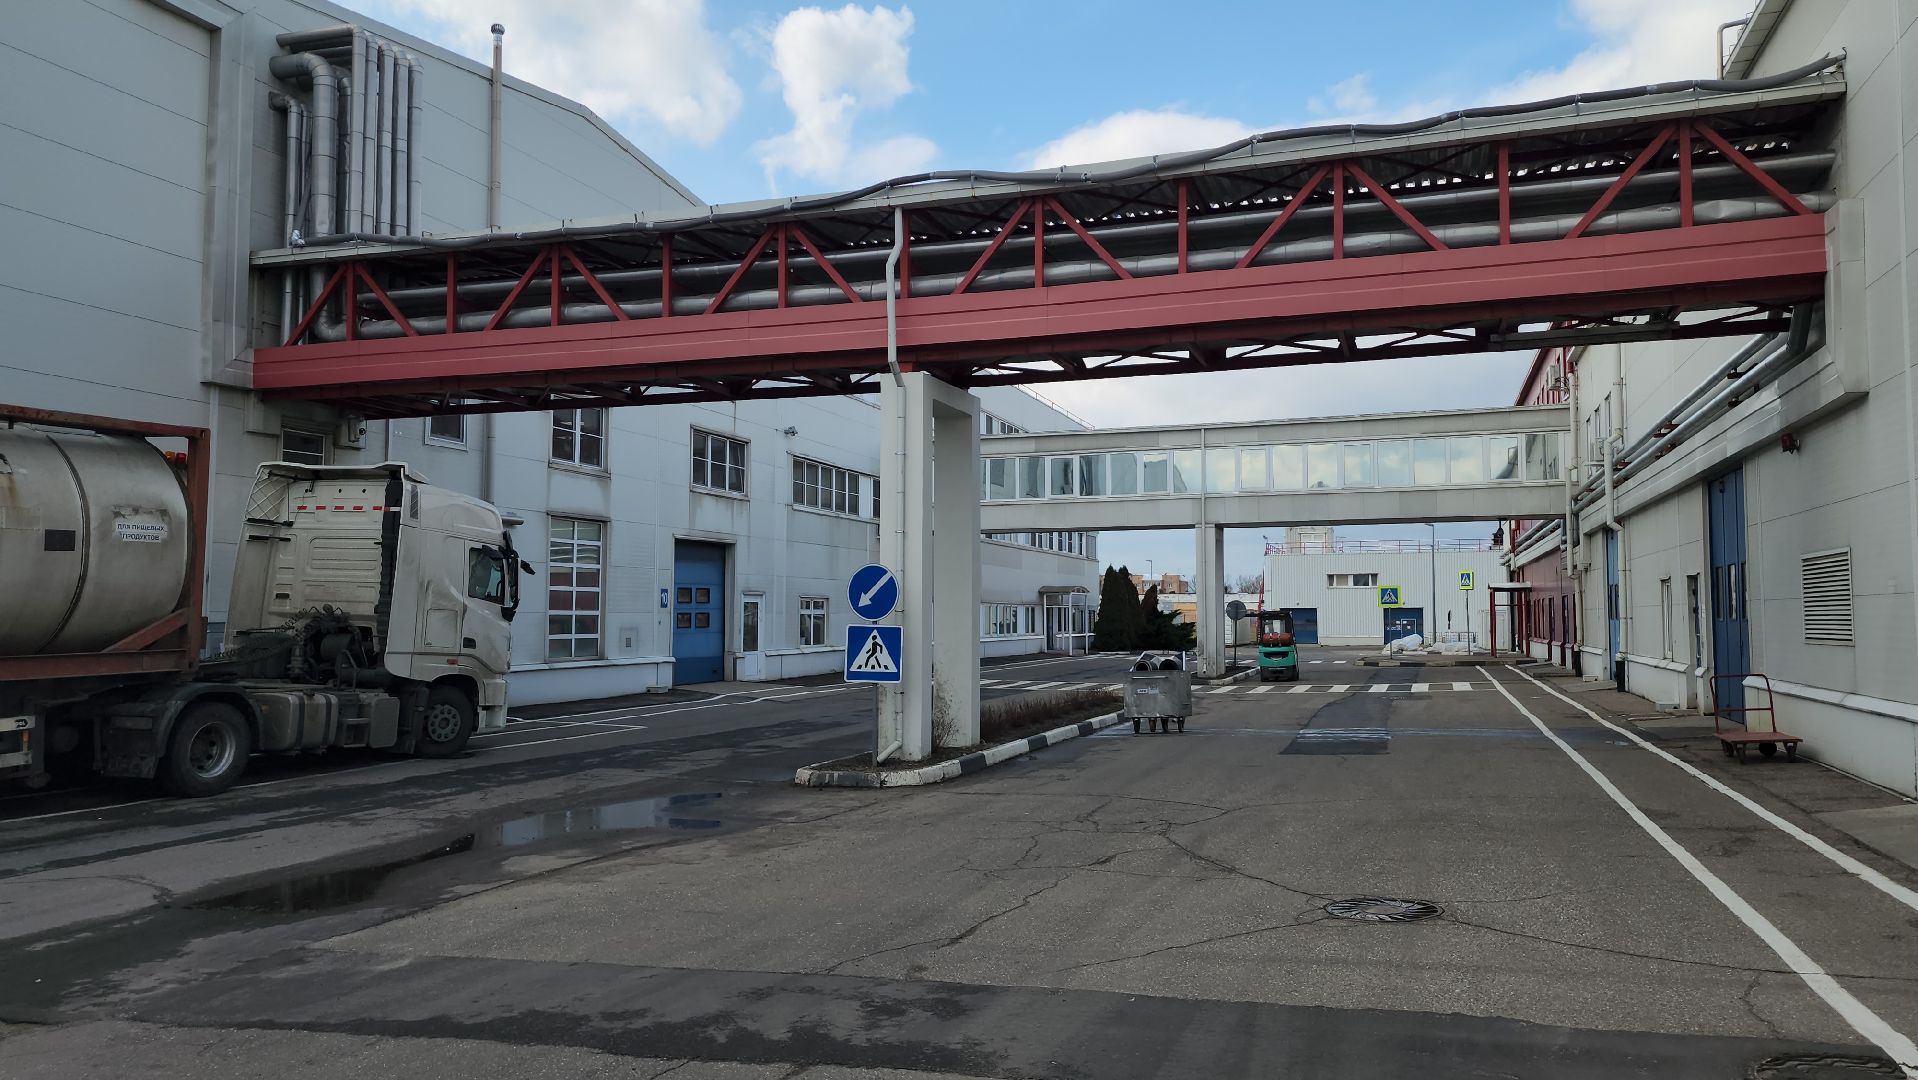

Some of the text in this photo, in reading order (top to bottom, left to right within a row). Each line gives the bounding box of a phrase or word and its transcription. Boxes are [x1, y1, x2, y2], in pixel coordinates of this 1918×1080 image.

[132, 524, 164, 532] ПИЩЕВЫХ
[122, 533, 160, 541] ПРОДУКТОВ
[661, 592, 668, 605] 10
